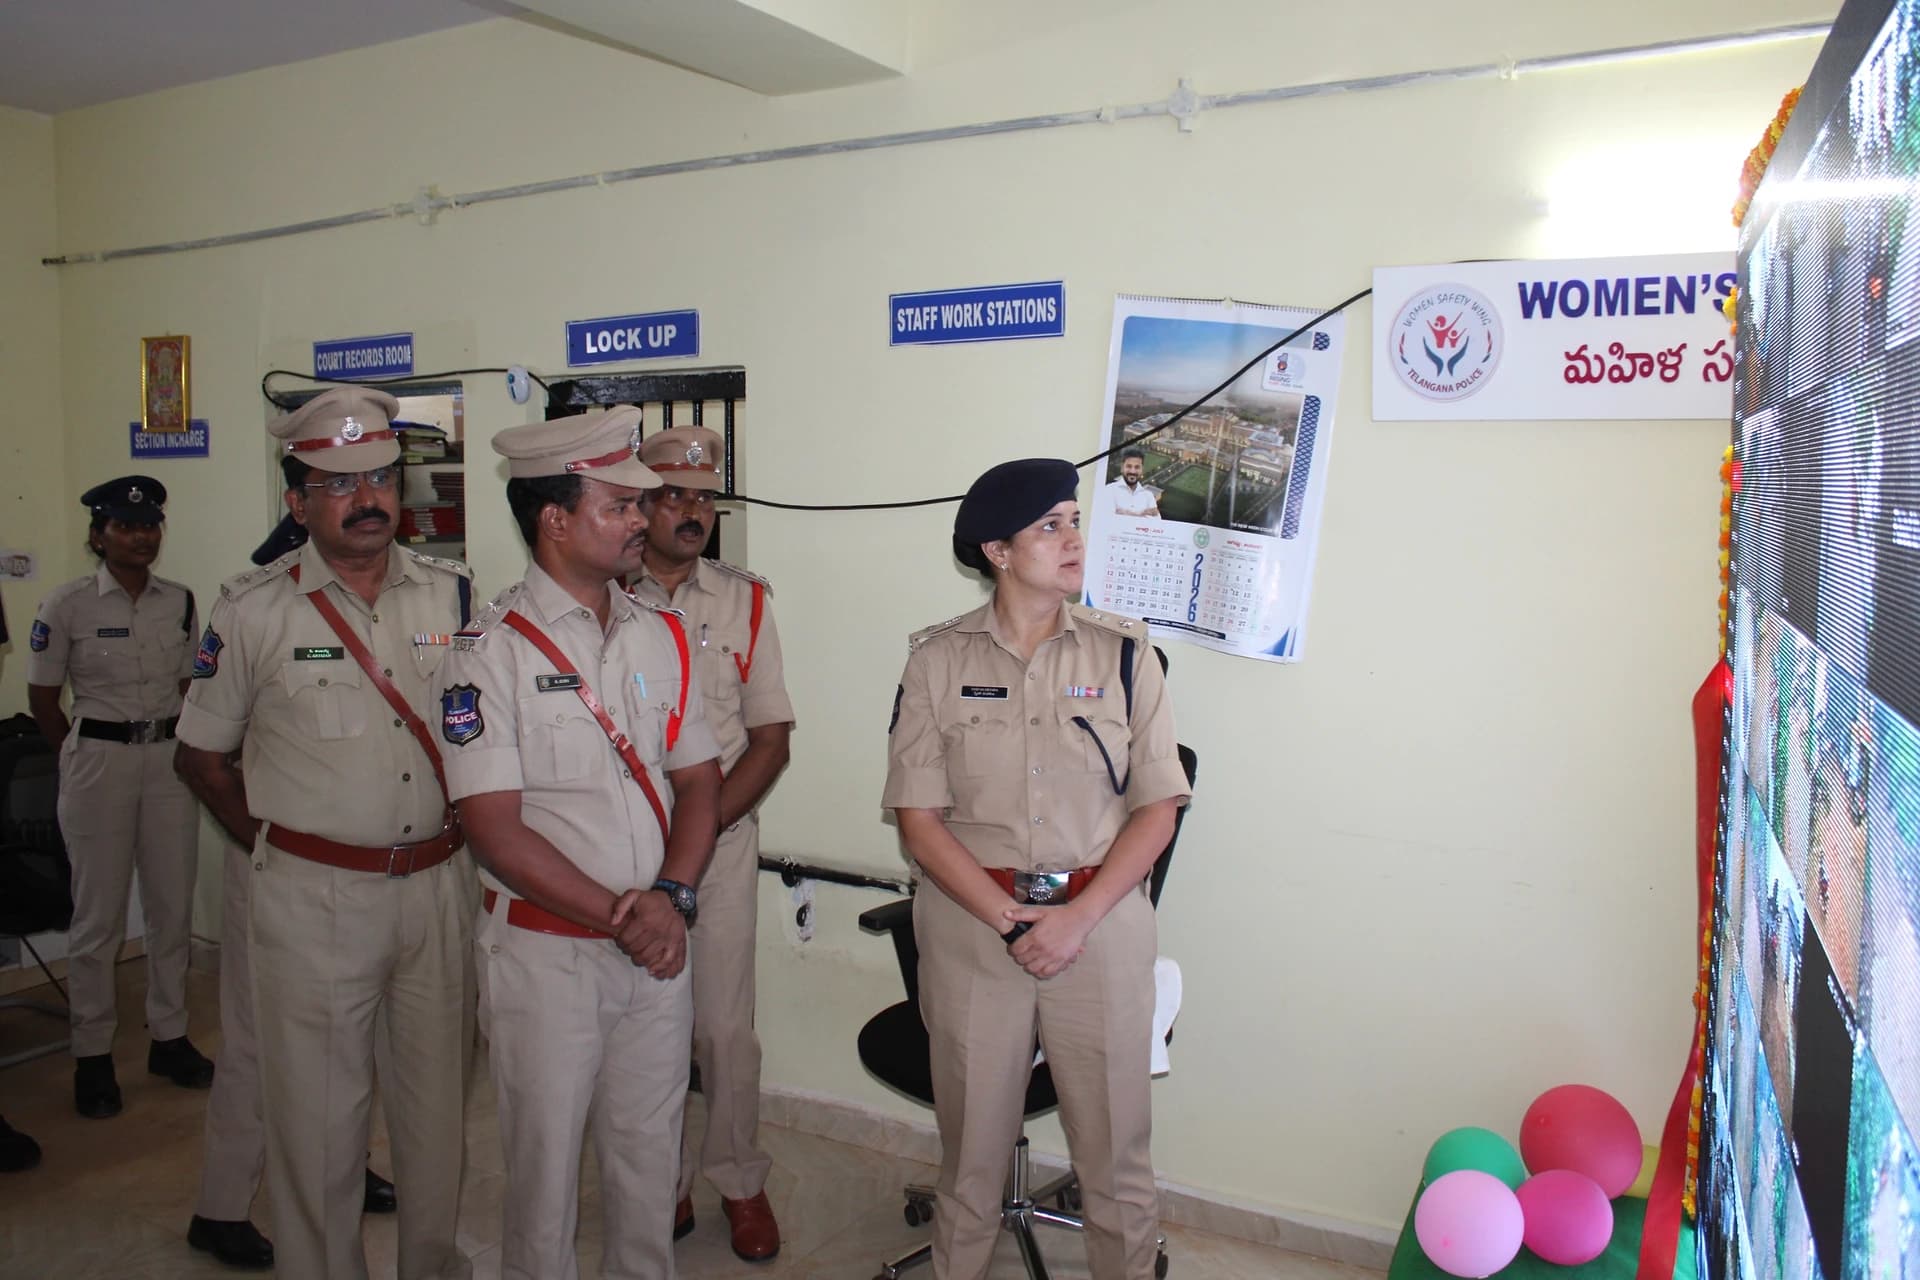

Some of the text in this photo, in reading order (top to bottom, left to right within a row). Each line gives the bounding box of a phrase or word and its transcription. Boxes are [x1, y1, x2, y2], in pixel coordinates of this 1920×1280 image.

[897, 297, 1057, 332] STAFF WORK STATIONS
[1403, 293, 1492, 327] WOMEN SAFETY WING
[586, 324, 677, 354] LOCK UP
[317, 345, 411, 371] COURT RECORDS ROOM
[1563, 339, 1735, 384] మహిళ స
[1407, 368, 1483, 392] TELANGANA POLICE
[135, 430, 205, 449] SECTION INCHARGE
[1188, 553, 1204, 622] 2026
